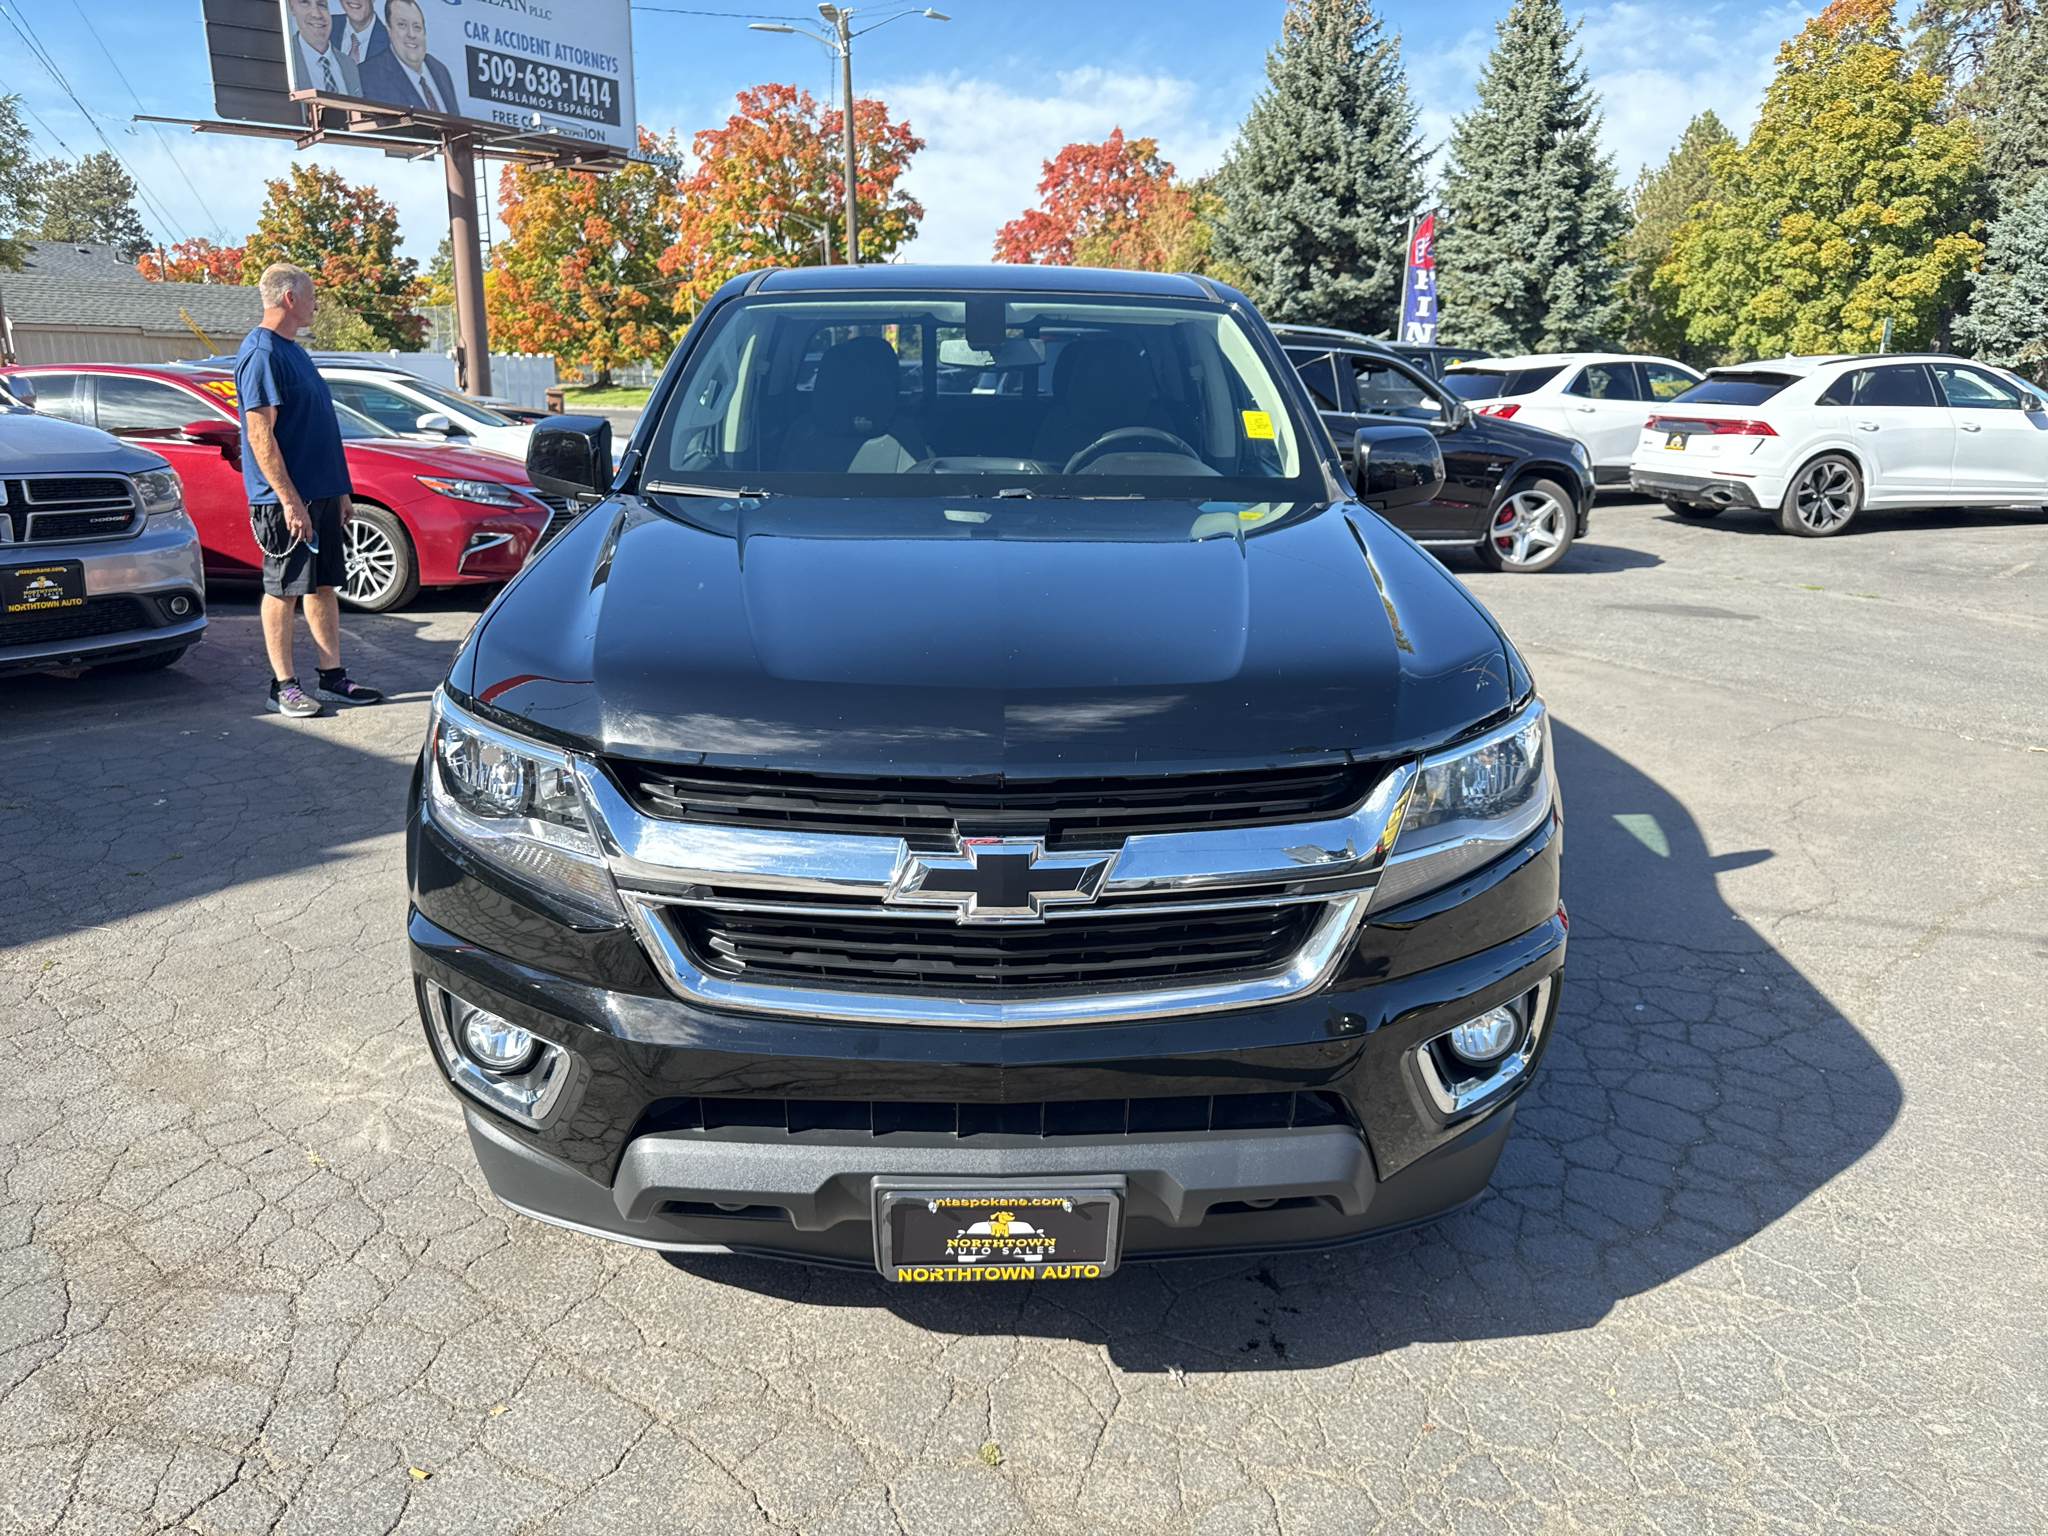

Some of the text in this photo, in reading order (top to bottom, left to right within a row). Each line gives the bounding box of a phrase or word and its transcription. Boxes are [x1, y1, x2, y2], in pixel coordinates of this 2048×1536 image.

[529, 5, 552, 20] PLLC
[464, 20, 619, 73] CAR ACCIDENT ATTORNEYS
[477, 52, 612, 108] 509-638-1414
[490, 87, 605, 120] HABLAMOS ESPAÑOL
[492, 110, 606, 142] FREE COTION
[23, 587, 63, 595] NORTHTOWN
[8, 598, 82, 612] NORTHTOWN AUTO
[936, 1197, 1066, 1208] ntaspokane.com
[945, 1246, 1056, 1255] AUTO SALES
[946, 1238, 1056, 1248] NORTHTOWN
[898, 1264, 1100, 1282] NORTHTOWN AUTO
